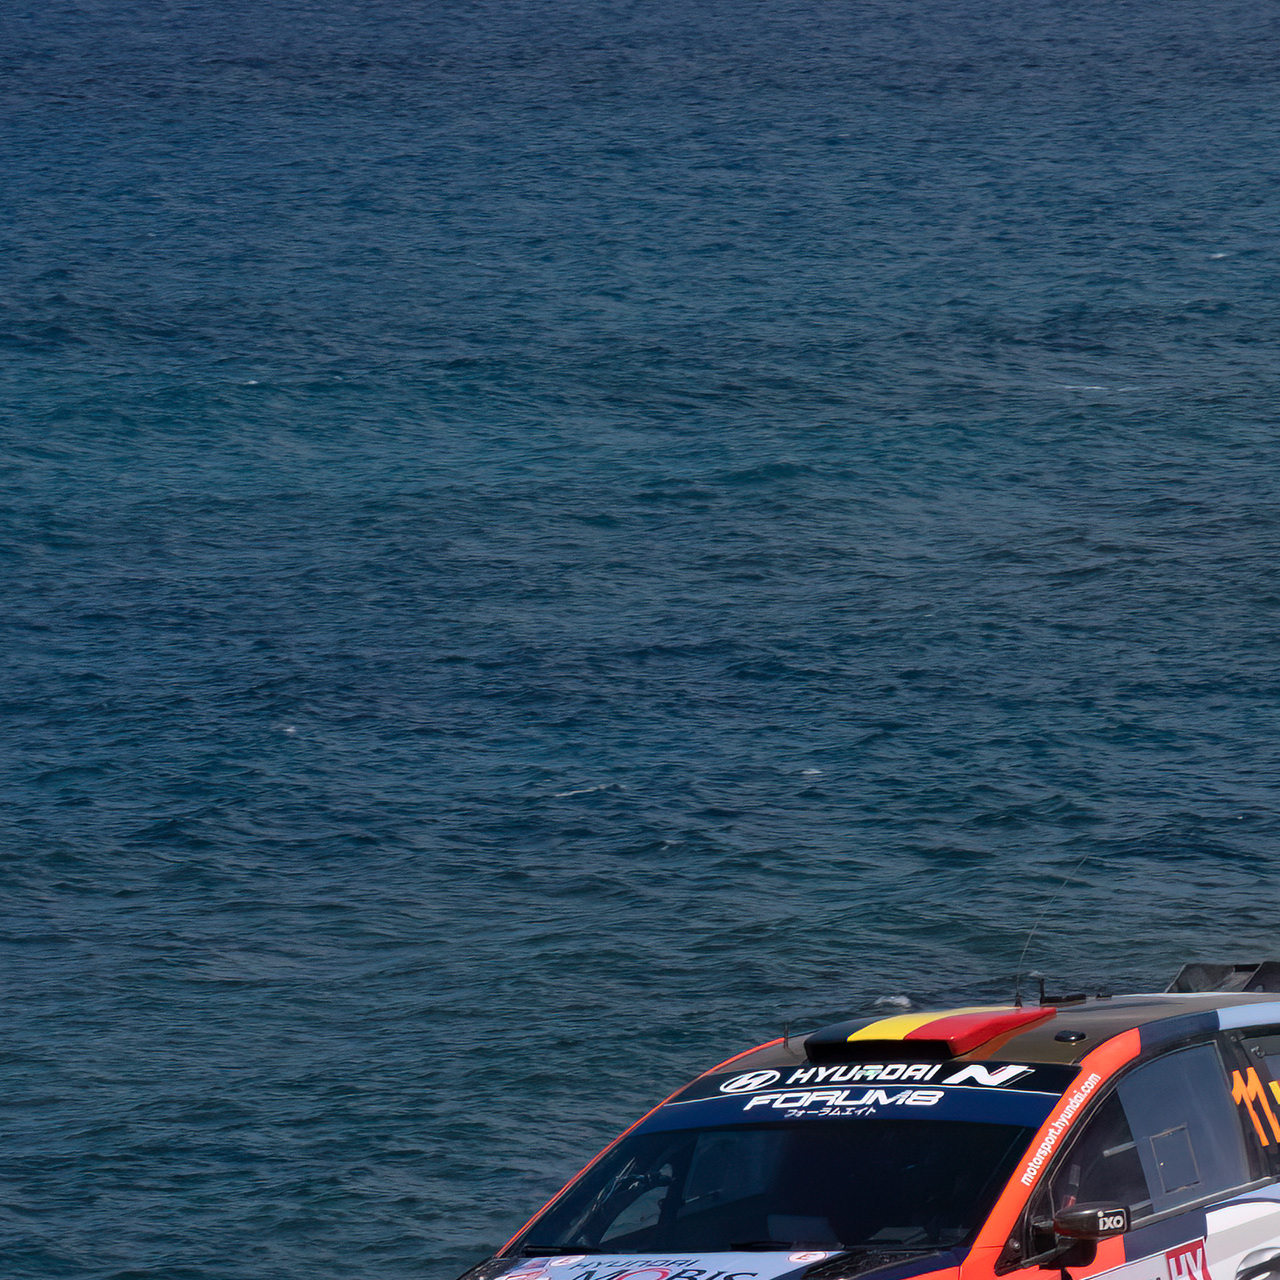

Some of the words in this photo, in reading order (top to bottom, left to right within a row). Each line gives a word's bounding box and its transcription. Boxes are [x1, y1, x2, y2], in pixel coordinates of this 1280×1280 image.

[785, 1064, 942, 1084] HYUNDAI
[743, 1089, 944, 1111] FORUM8
[784, 1106, 877, 1119] フォーラムエイト
[1020, 1073, 1102, 1187] motorsport.hyundai.com
[568, 1259, 701, 1271] HYUNDAI
